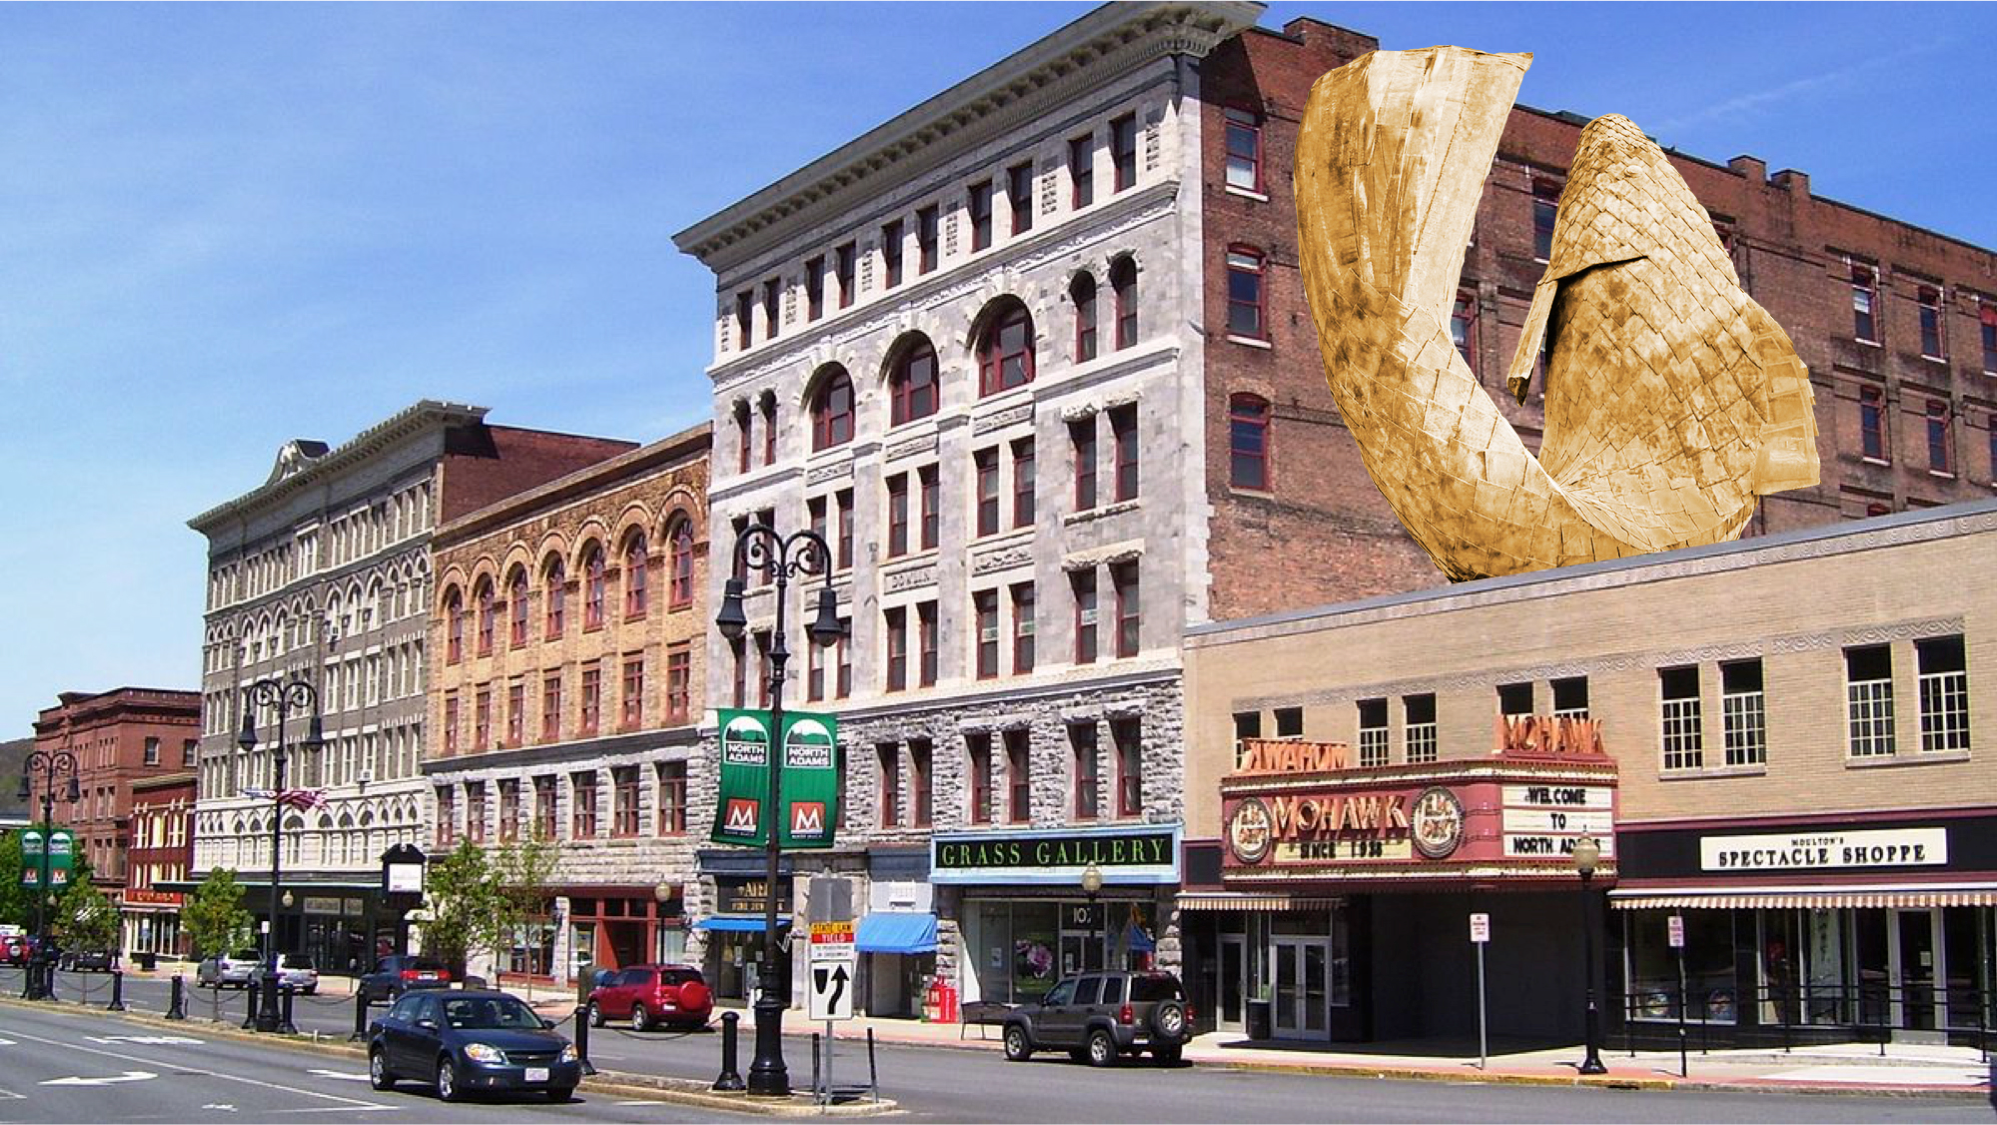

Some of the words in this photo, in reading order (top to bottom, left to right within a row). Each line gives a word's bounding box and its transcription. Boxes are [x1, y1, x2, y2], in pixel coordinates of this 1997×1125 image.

[1499, 715, 1604, 752] MOHAWK
[728, 743, 765, 754] NORTH
[788, 747, 828, 757] NORTH
[728, 753, 765, 764] ADAMS
[788, 756, 829, 766] ADAMS
[1527, 786, 1586, 804] WELCOME
[730, 804, 754, 826] M
[795, 807, 821, 830] M
[1272, 796, 1409, 838] MOHAWK
[1550, 813, 1566, 830] TO
[1300, 841, 1337, 859] SINCE
[1513, 836, 1553, 854] NORTH
[1791, 837, 1844, 847] MOULTON'S
[941, 843, 1021, 866] GRASS
[1036, 838, 1166, 865] GALLERY
[1719, 848, 1830, 867] SPECTACLE
[1842, 844, 1926, 864] SHOPPE
[821, 933, 846, 944] YIELD
